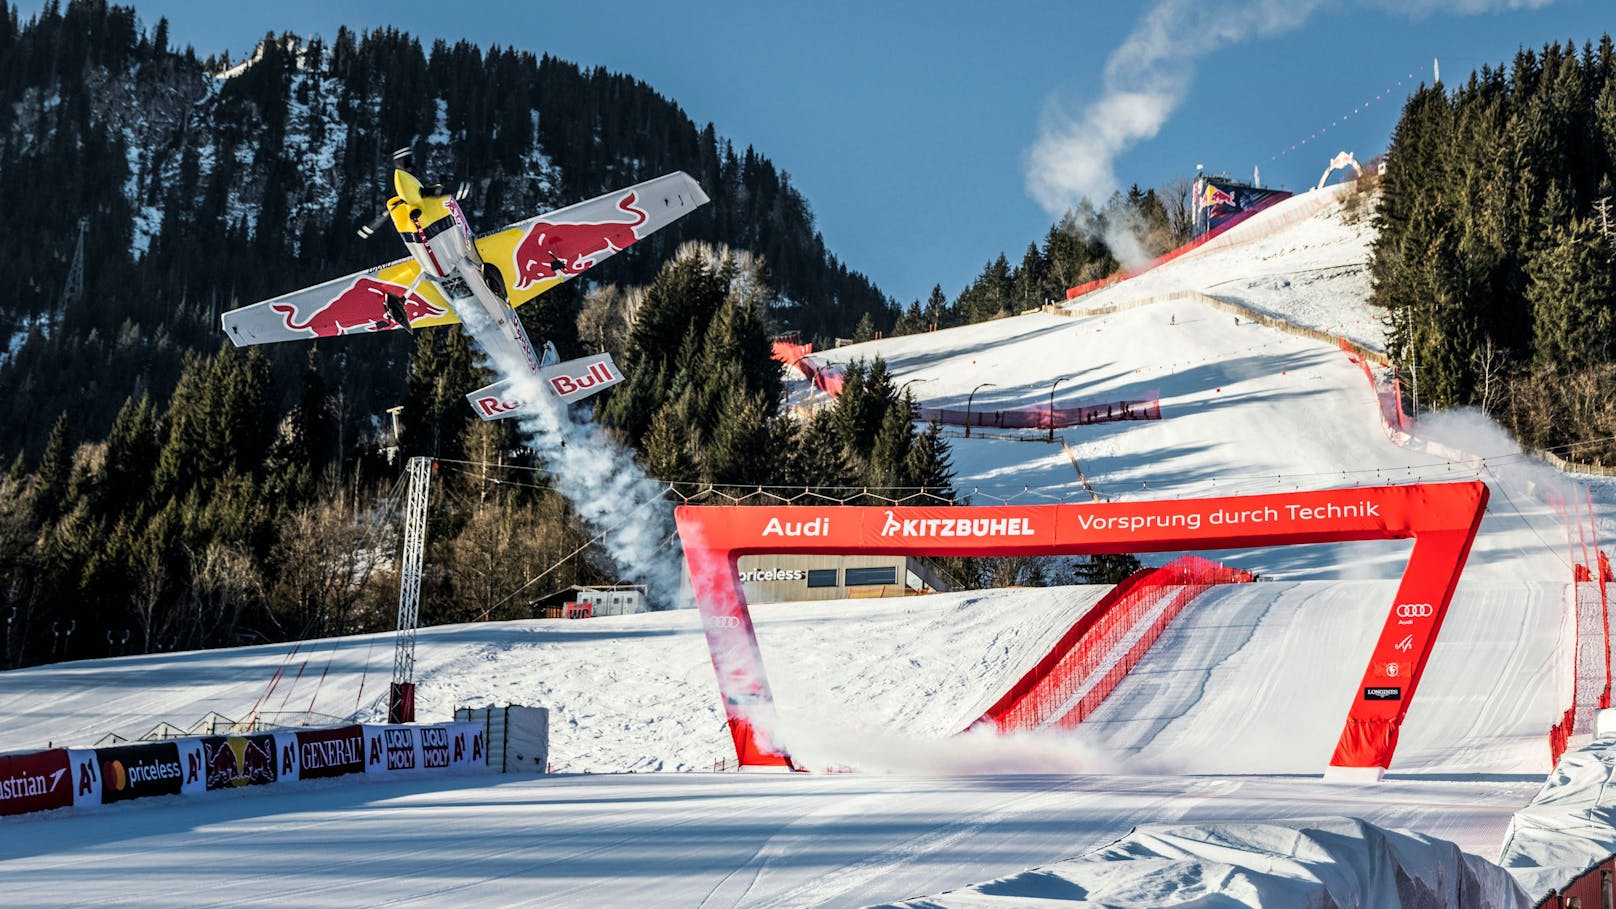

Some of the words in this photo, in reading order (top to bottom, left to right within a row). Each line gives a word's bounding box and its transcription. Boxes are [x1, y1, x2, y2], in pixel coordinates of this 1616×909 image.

[549, 361, 616, 397] Bull
[1077, 511, 1202, 533] Vorsprung
[1208, 505, 1279, 525] durch
[1285, 500, 1381, 521] Technik
[762, 517, 830, 537] Audi
[385, 729, 414, 748] LIQUI
[421, 728, 448, 748] LIQUI
[301, 736, 363, 770] GENERALI
[388, 749, 415, 769] MOLY
[424, 748, 449, 767] MOLY
[128, 759, 182, 789] priceless
